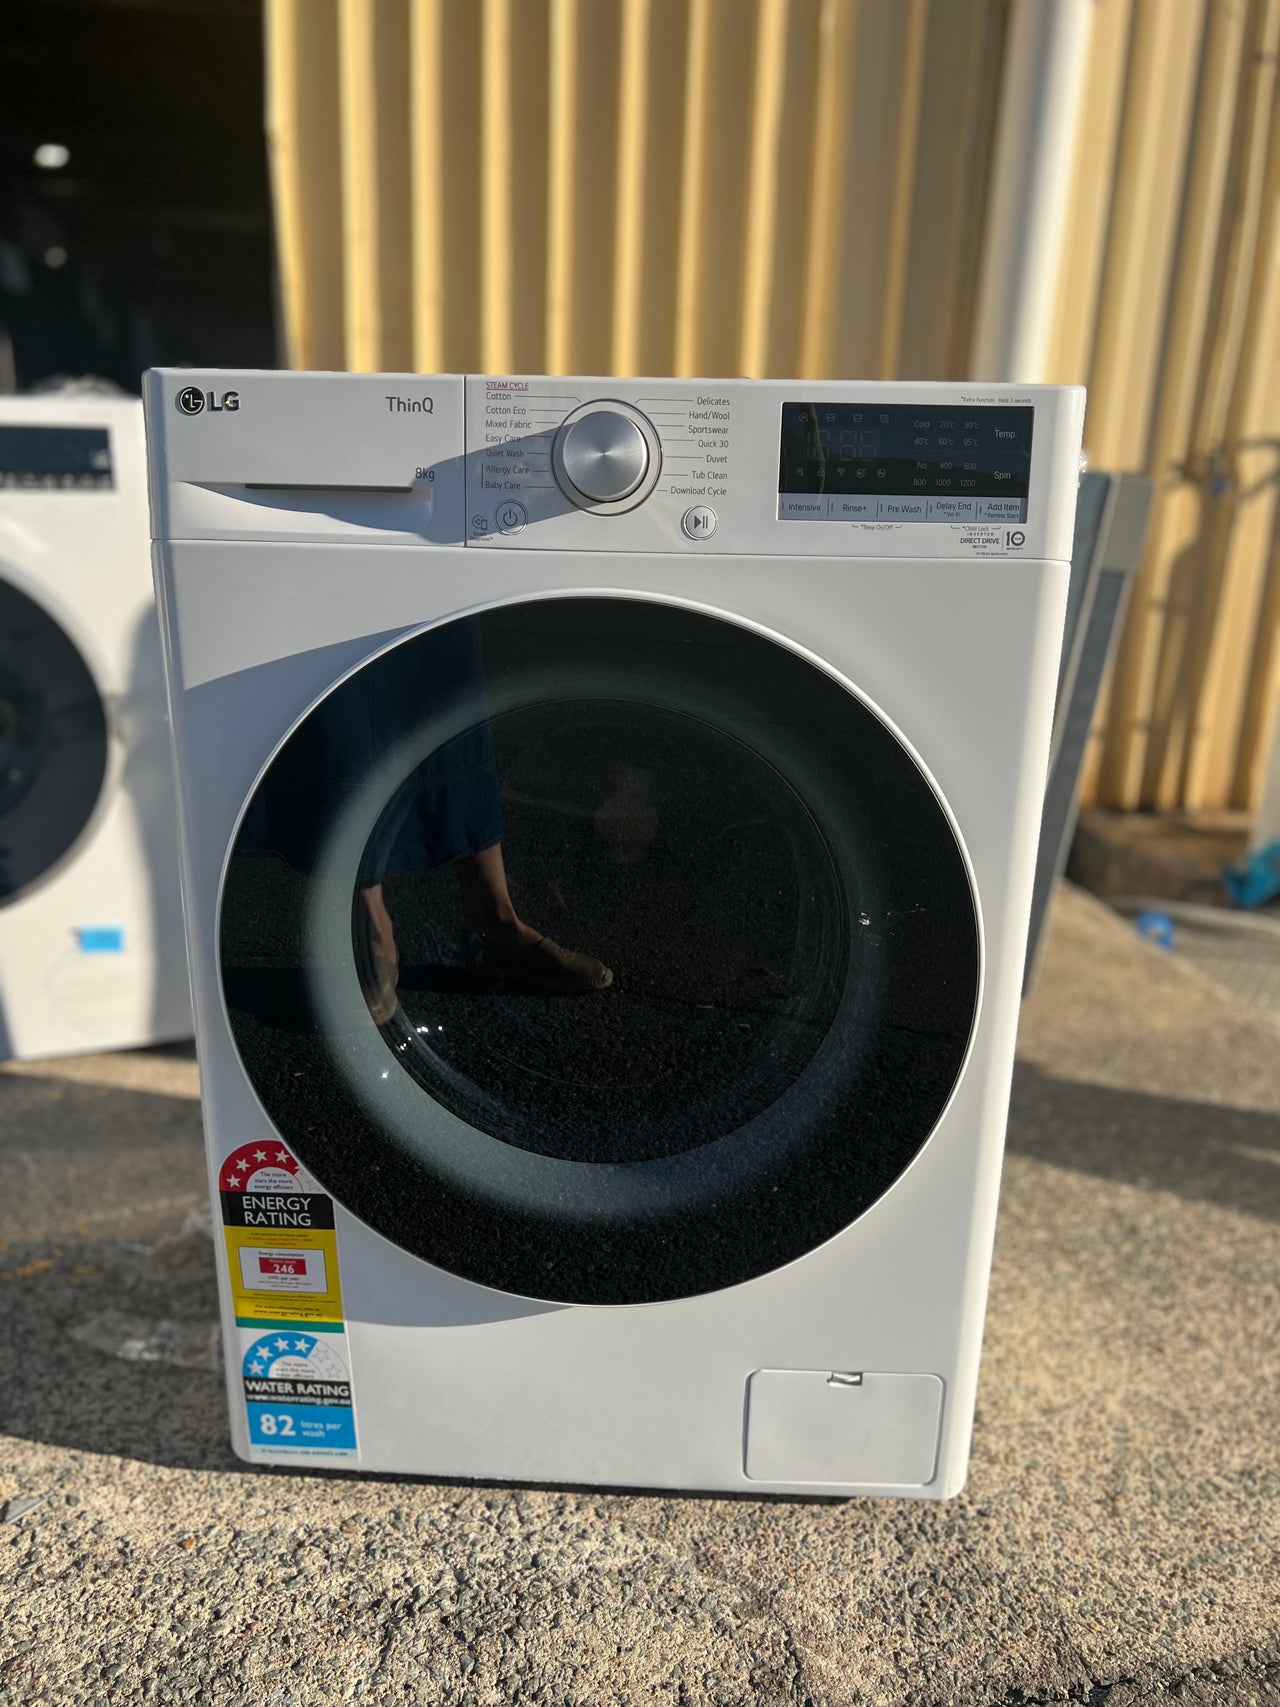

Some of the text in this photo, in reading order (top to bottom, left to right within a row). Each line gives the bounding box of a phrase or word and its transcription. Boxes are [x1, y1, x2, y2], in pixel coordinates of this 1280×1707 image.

[486, 392, 511, 400] Cotton
[208, 391, 240, 411] LG
[386, 397, 434, 414] ThinQ
[697, 397, 730, 406] Delicates
[486, 406, 526, 415] Cotton Eco
[689, 411, 730, 420] Hand/Wool
[486, 420, 532, 429] Mixed Fabric
[914, 420, 930, 429] Cold
[688, 425, 729, 435] Sportswear
[486, 434, 521, 444] Easy Care
[698, 440, 729, 448] Quick 30
[486, 449, 524, 458] Quiet Wash
[706, 454, 728, 463] Duvet
[486, 465, 530, 476] Allergy Care
[940, 462, 952, 470] 400
[964, 462, 977, 470] 600
[415, 467, 435, 482] 8kg
[692, 471, 728, 480] Tub Clean
[994, 471, 1011, 480] Spin
[485, 481, 520, 490] Baby Care
[936, 479, 951, 487] 1000
[960, 479, 976, 487] 1200
[671, 486, 727, 497] Download Cycle
[789, 503, 821, 512] Intensive
[843, 504, 867, 512] Rinse+
[888, 505, 921, 513] Pre Wash
[936, 502, 972, 511] Delay End
[987, 503, 1002, 511] Add
[1006, 531, 1025, 546] 10
[242, 1196, 311, 1211] ENERGY
[244, 1212, 311, 1226] RATING
[273, 1264, 295, 1274] 246
[245, 1380, 349, 1396] WATER RATING
[260, 1413, 296, 1436] 82
[326, 1423, 341, 1431] per
[302, 1430, 325, 1438] wash
